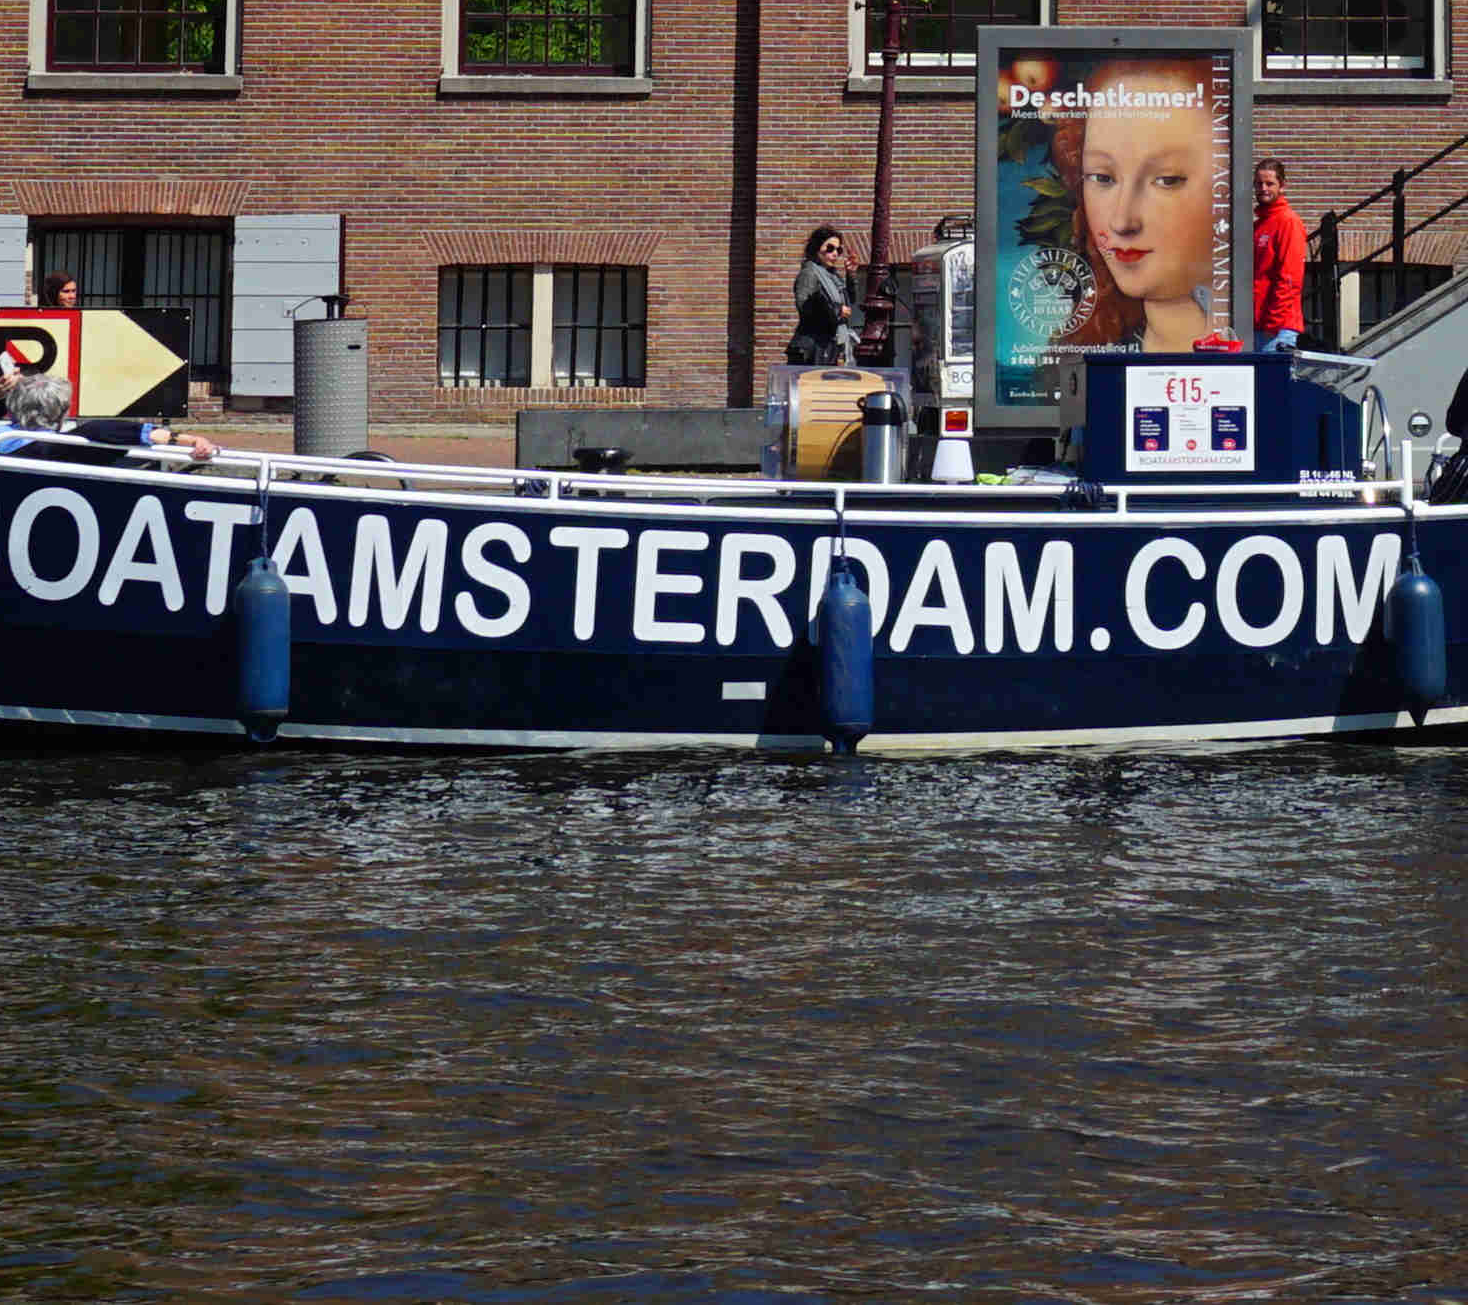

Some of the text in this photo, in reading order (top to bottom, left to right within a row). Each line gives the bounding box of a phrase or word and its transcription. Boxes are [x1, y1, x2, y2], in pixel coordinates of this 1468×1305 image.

[1010, 82, 1205, 108] De schatkamer!
[1011, 109, 1087, 119] Meesterwerken
[1212, 55, 1231, 215] HERMITAGE
[1212, 243, 1231, 335] AMSTE
[1128, 343, 1140, 353] #1
[1165, 376, 1221, 405] €15,-
